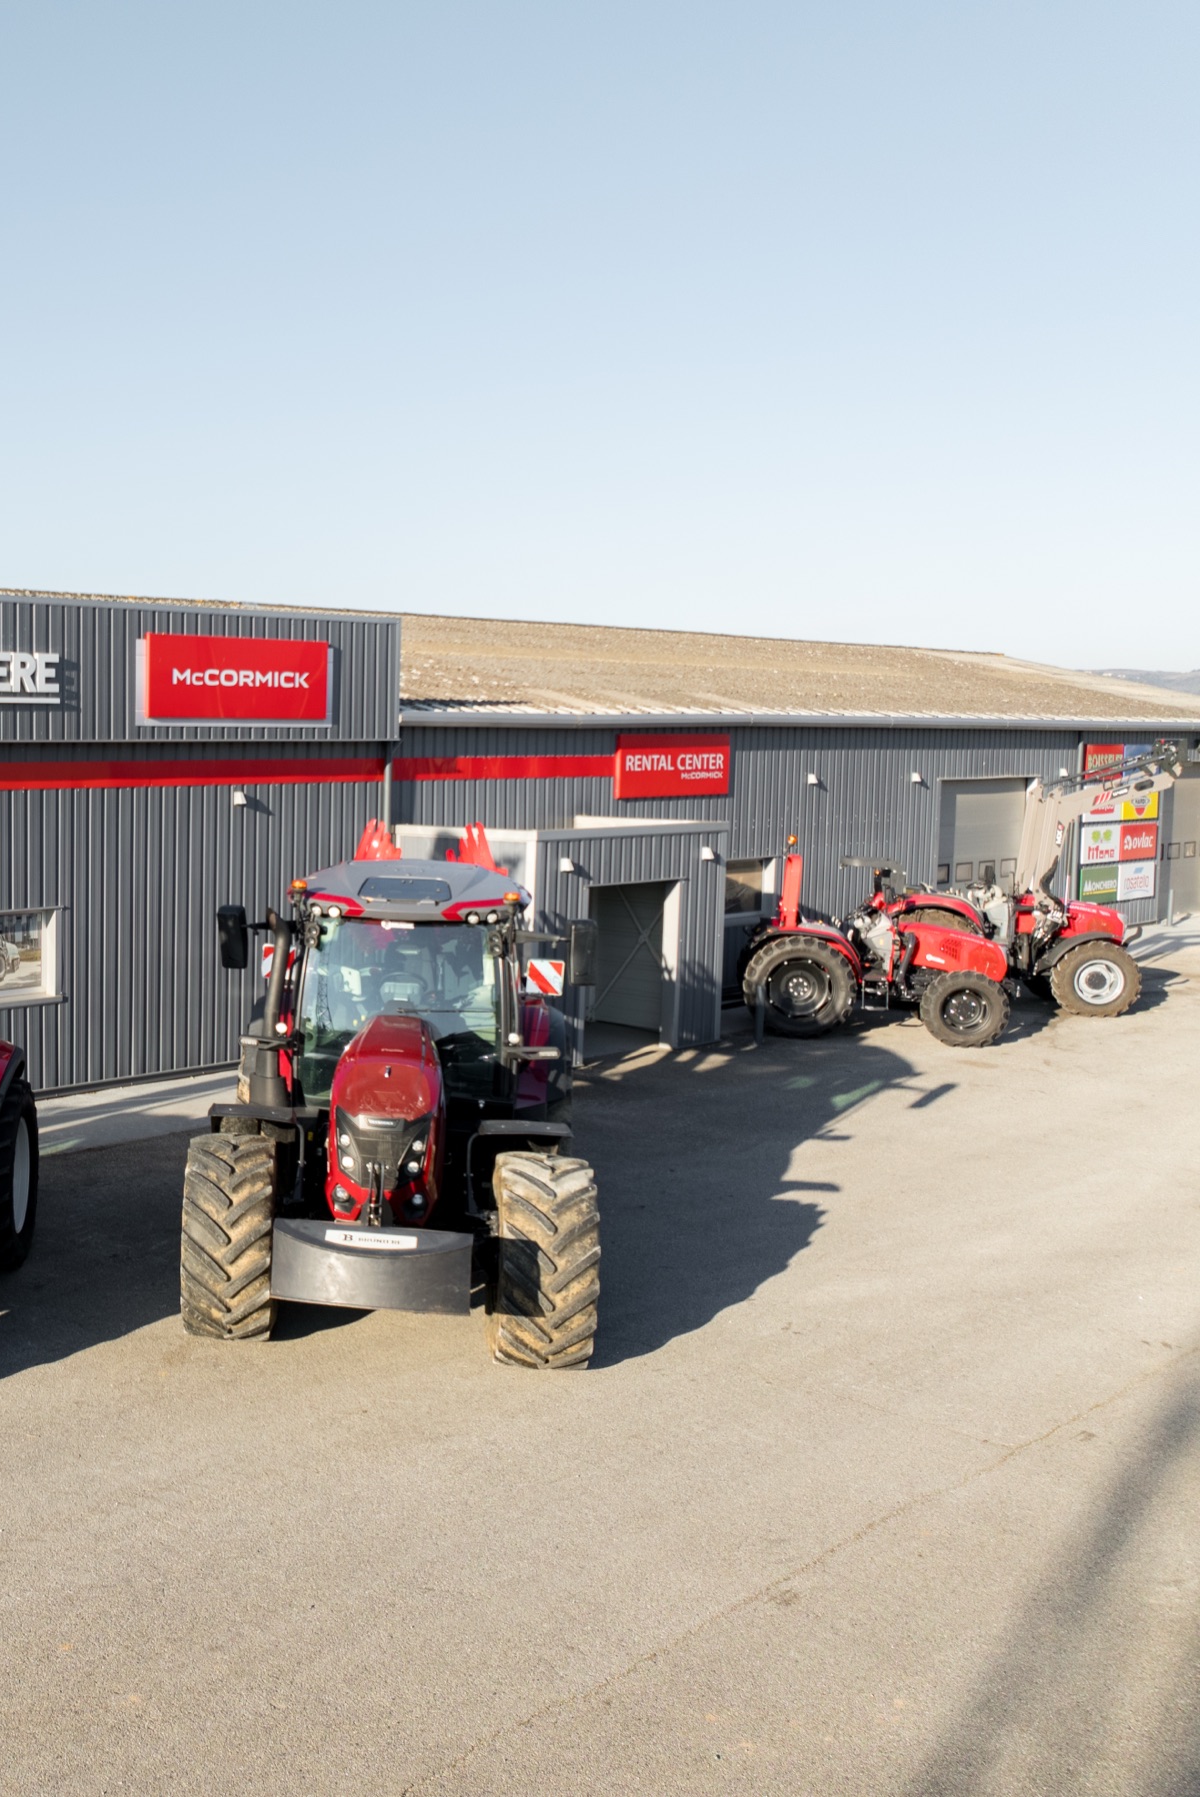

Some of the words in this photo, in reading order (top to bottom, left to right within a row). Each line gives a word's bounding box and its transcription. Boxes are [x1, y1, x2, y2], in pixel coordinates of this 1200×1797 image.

[171, 667, 310, 689] McCORMICK
[625, 754, 675, 772] RENTAL
[676, 753, 724, 771] CENTER
[681, 771, 724, 780] McCORMICK
[1133, 832, 1154, 849] ovlac
